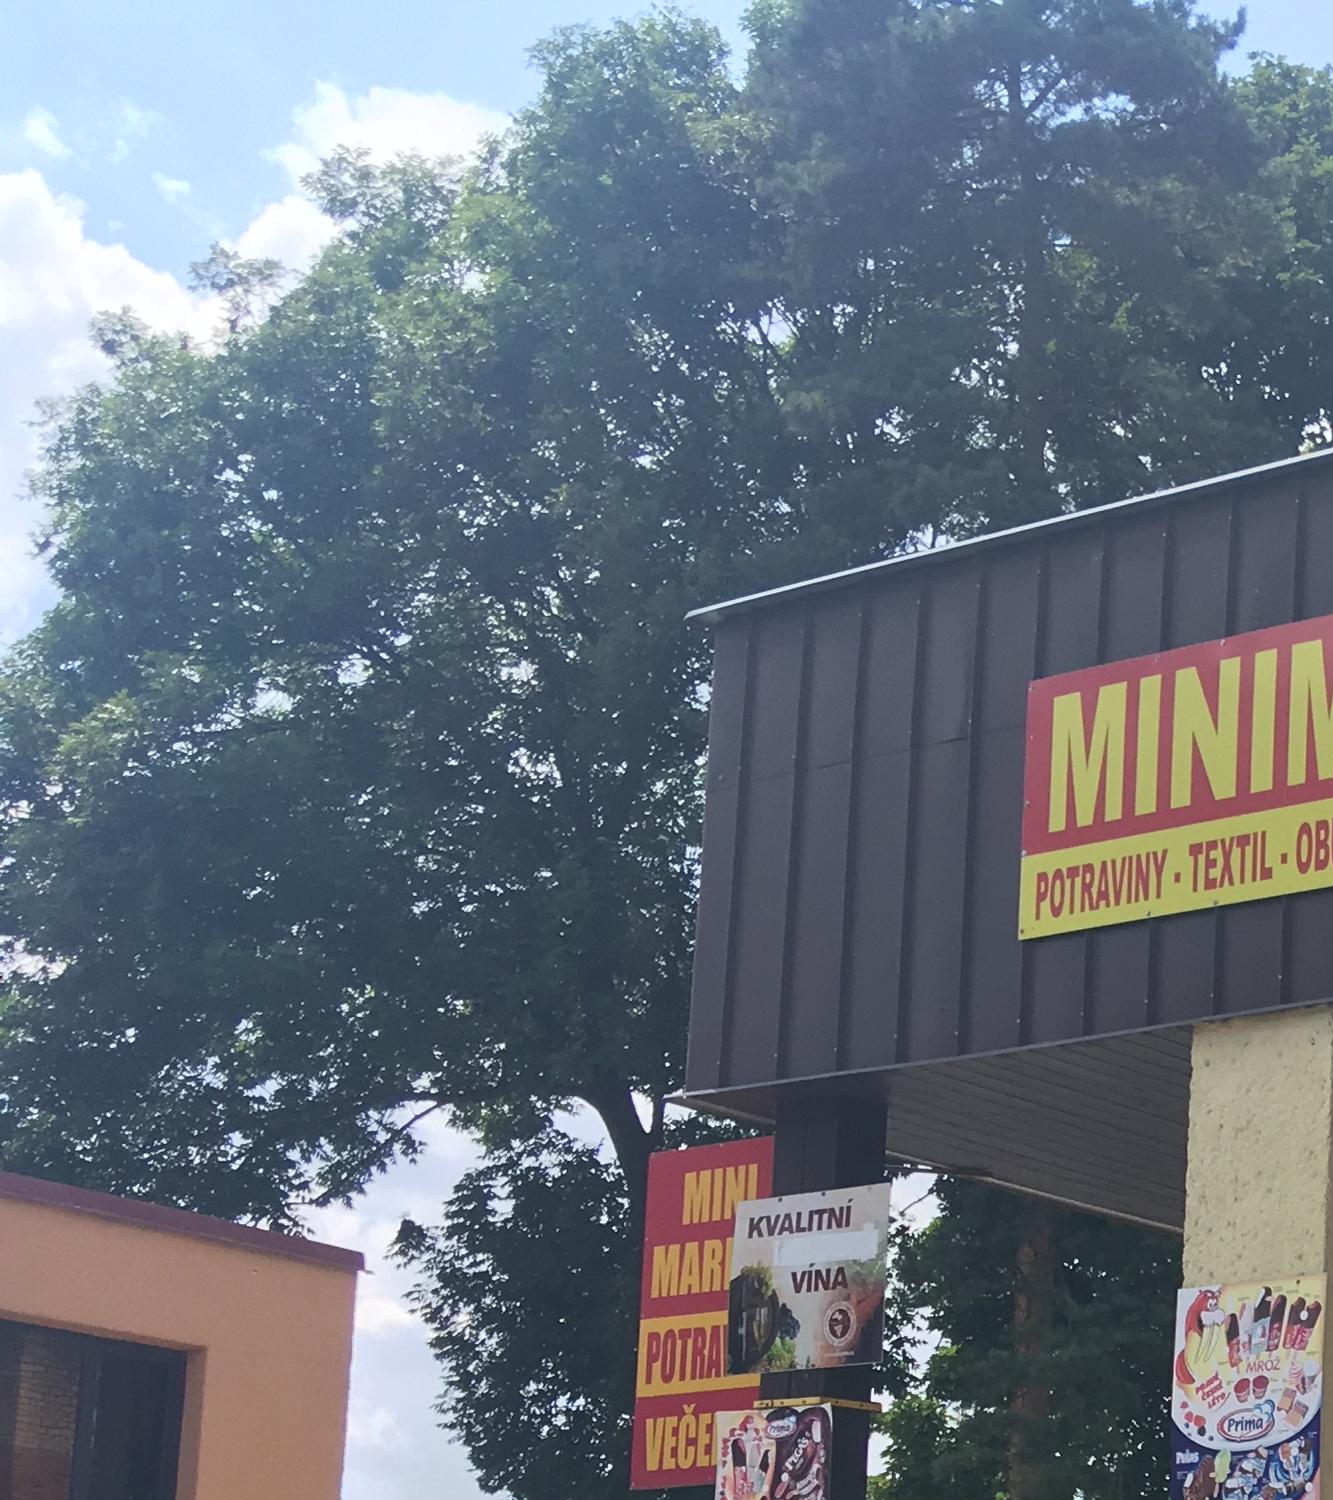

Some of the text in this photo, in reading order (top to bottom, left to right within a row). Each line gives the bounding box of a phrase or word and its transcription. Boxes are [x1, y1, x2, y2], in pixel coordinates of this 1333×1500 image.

[1034, 849, 1167, 921] POTRAVINY
[1188, 829, 1273, 893] TEXTIL
[683, 1163, 759, 1226] MINI
[747, 1199, 854, 1240] KVALITNÍ
[791, 1263, 849, 1295] VÍNA
[769, 1423, 792, 1434] Prima
[1227, 1417, 1264, 1432] Prima
